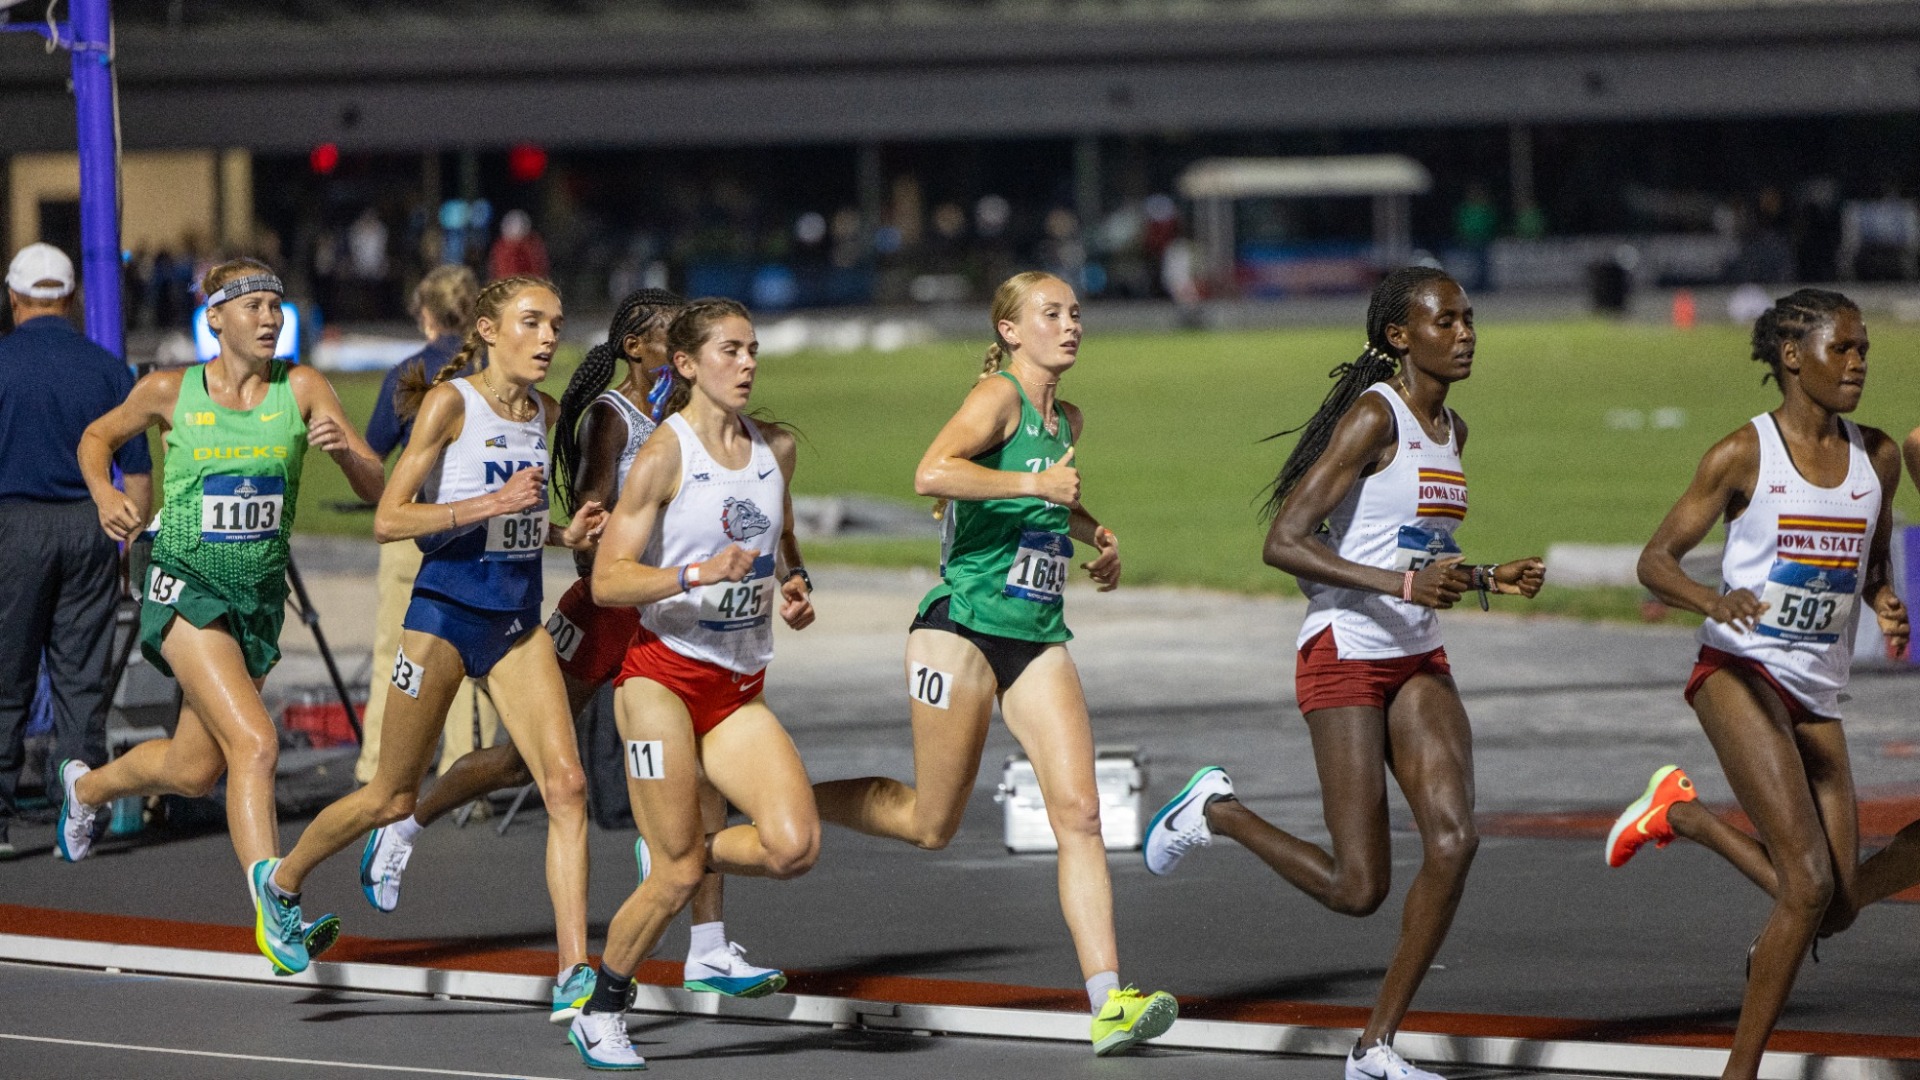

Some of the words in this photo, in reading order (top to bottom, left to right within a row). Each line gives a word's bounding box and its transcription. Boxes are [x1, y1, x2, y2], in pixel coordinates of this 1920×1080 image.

[193, 446, 289, 461] DUCKS
[1419, 485, 1448, 500] IOWA
[212, 501, 276, 530] 1103
[503, 517, 543, 549] 935
[1777, 534, 1815, 550] IOWA
[1819, 536, 1864, 553] STATE
[152, 571, 177, 602] 43
[1017, 554, 1065, 592] 1649
[718, 584, 764, 619] 425
[1777, 593, 1837, 631] 593
[917, 667, 943, 705] 10
[631, 743, 654, 777] 11
